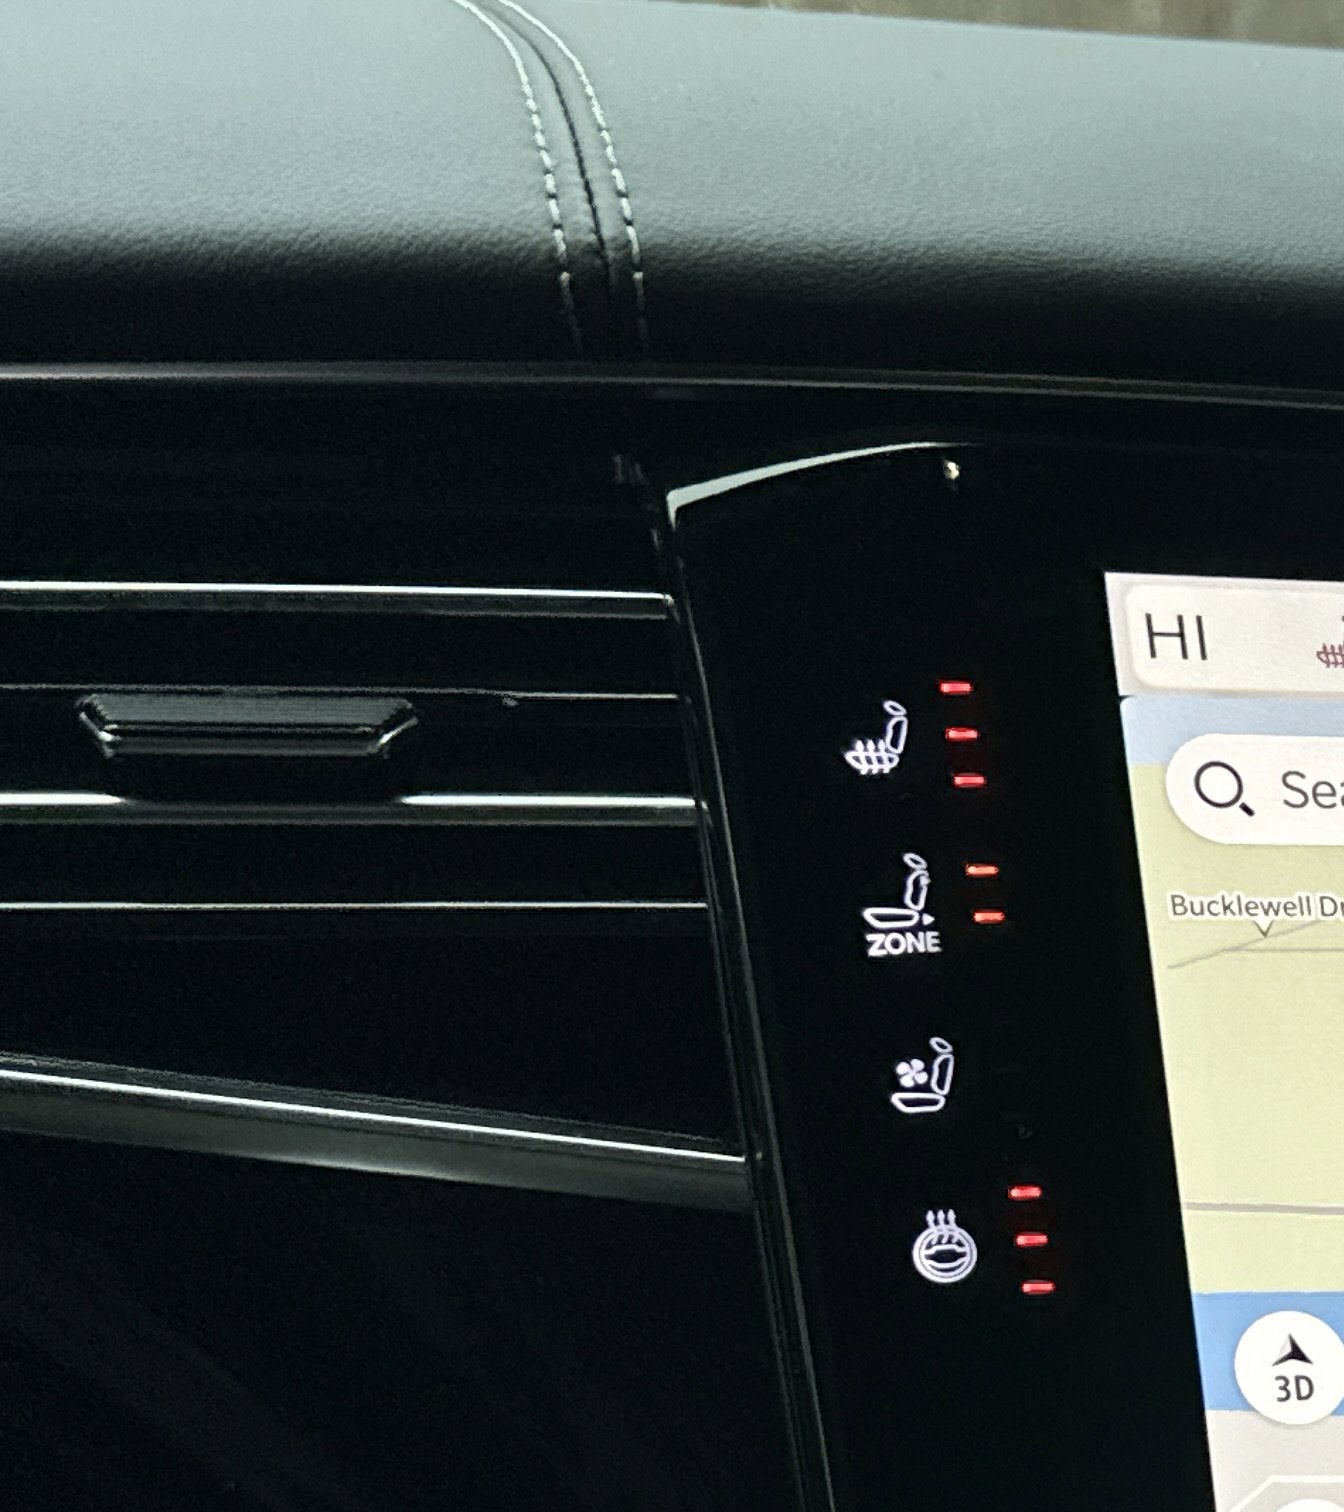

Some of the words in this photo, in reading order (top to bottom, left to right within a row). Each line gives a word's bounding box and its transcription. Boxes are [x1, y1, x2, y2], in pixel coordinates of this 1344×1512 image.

[1145, 613, 1208, 661] HI
[1170, 894, 1313, 918] Bucklewell
[867, 930, 942, 957] ZONE
[1275, 1375, 1315, 1403] 3D
